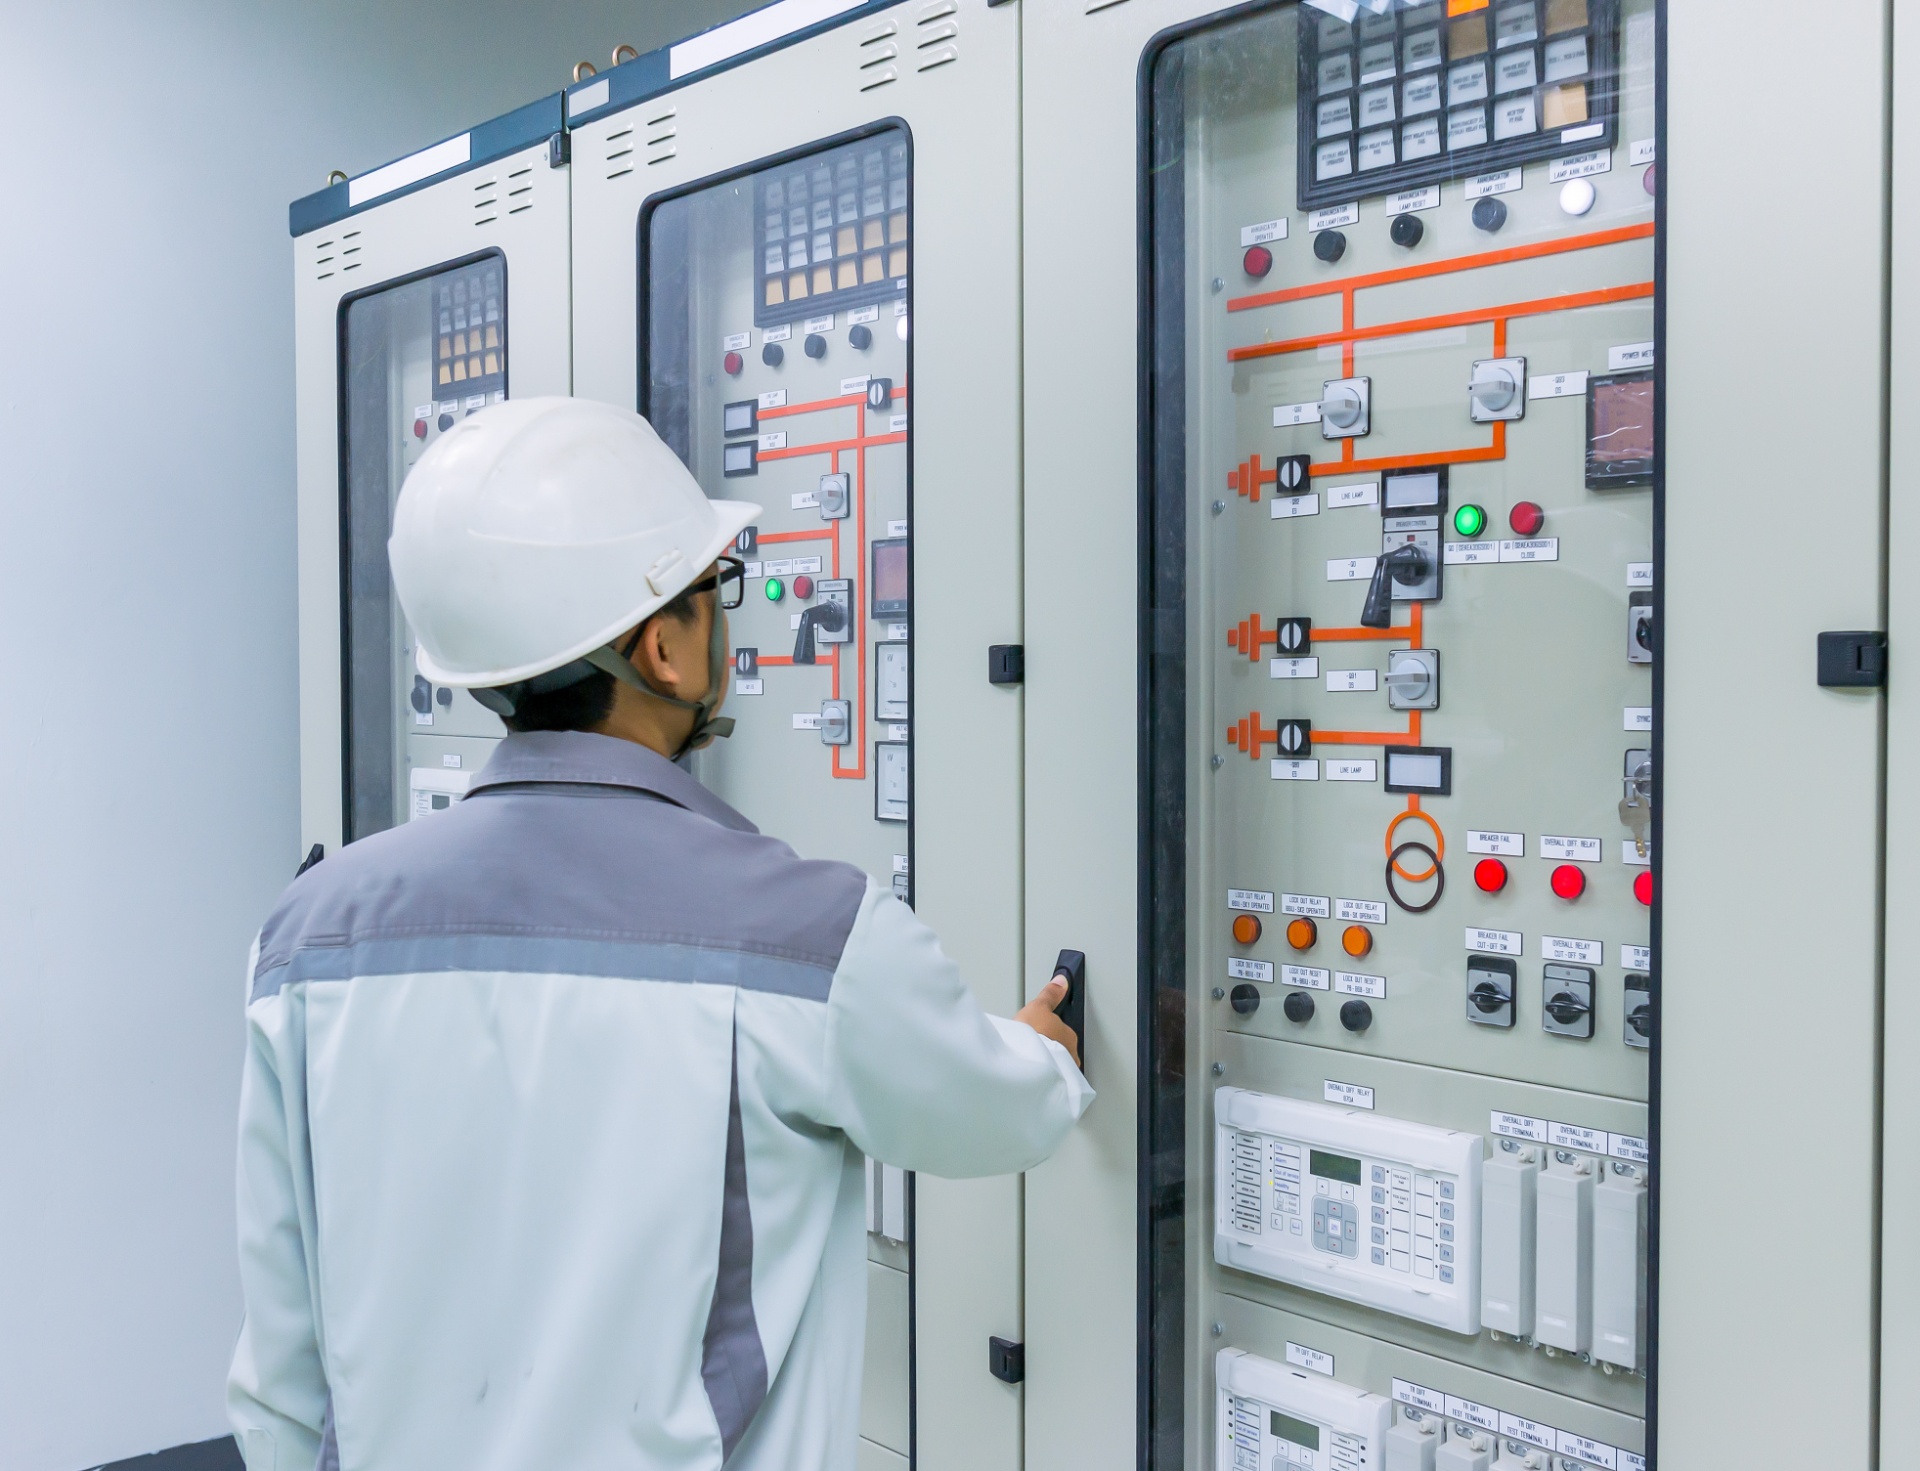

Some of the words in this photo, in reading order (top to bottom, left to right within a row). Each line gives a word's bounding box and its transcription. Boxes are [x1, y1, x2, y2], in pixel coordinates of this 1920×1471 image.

[1554, 172, 1567, 180] LAMP
[1584, 162, 1606, 173] HEALTHY
[1622, 352, 1639, 360] POWER
[1641, 349, 1654, 358] MET
[1480, 834, 1499, 842] BREAKER
[1544, 838, 1565, 847] OVERALL
[1251, 902, 1270, 910] OPERATED
[1306, 907, 1326, 915] OPERATED
[1360, 912, 1380, 920] OPERATED
[1477, 931, 1497, 940] BREAKER
[1476, 941, 1498, 950] CUT-OFF
[1552, 939, 1574, 948] OVERALL
[1575, 942, 1590, 950] RELAY
[1554, 950, 1577, 959] CUT-OFF
[1309, 969, 1322, 977] RESET
[1327, 1083, 1344, 1092] OVERALL
[1502, 1115, 1521, 1126] OVERALL
[1511, 1127, 1534, 1138] TERMINAL
[1560, 1126, 1581, 1136] OVERALL
[1556, 1136, 1567, 1144] TEST
[1570, 1138, 1594, 1150] TERMINAL
[1622, 1137, 1643, 1148] OVERALL
[1617, 1147, 1629, 1156] TEST
[1312, 1352, 1324, 1360] RELAY
[1400, 1392, 1410, 1401] TEST
[1412, 1395, 1432, 1408] TERMINAL
[1452, 1408, 1462, 1418] TEST
[1464, 1412, 1486, 1426] TERMINAL
[1507, 1426, 1518, 1436] TEST
[1520, 1429, 1543, 1443] TERMINAL
[1565, 1445, 1576, 1455] TEST
[1579, 1449, 1602, 1463] TERMINAL
[1626, 1454, 1639, 1463] LOCK
